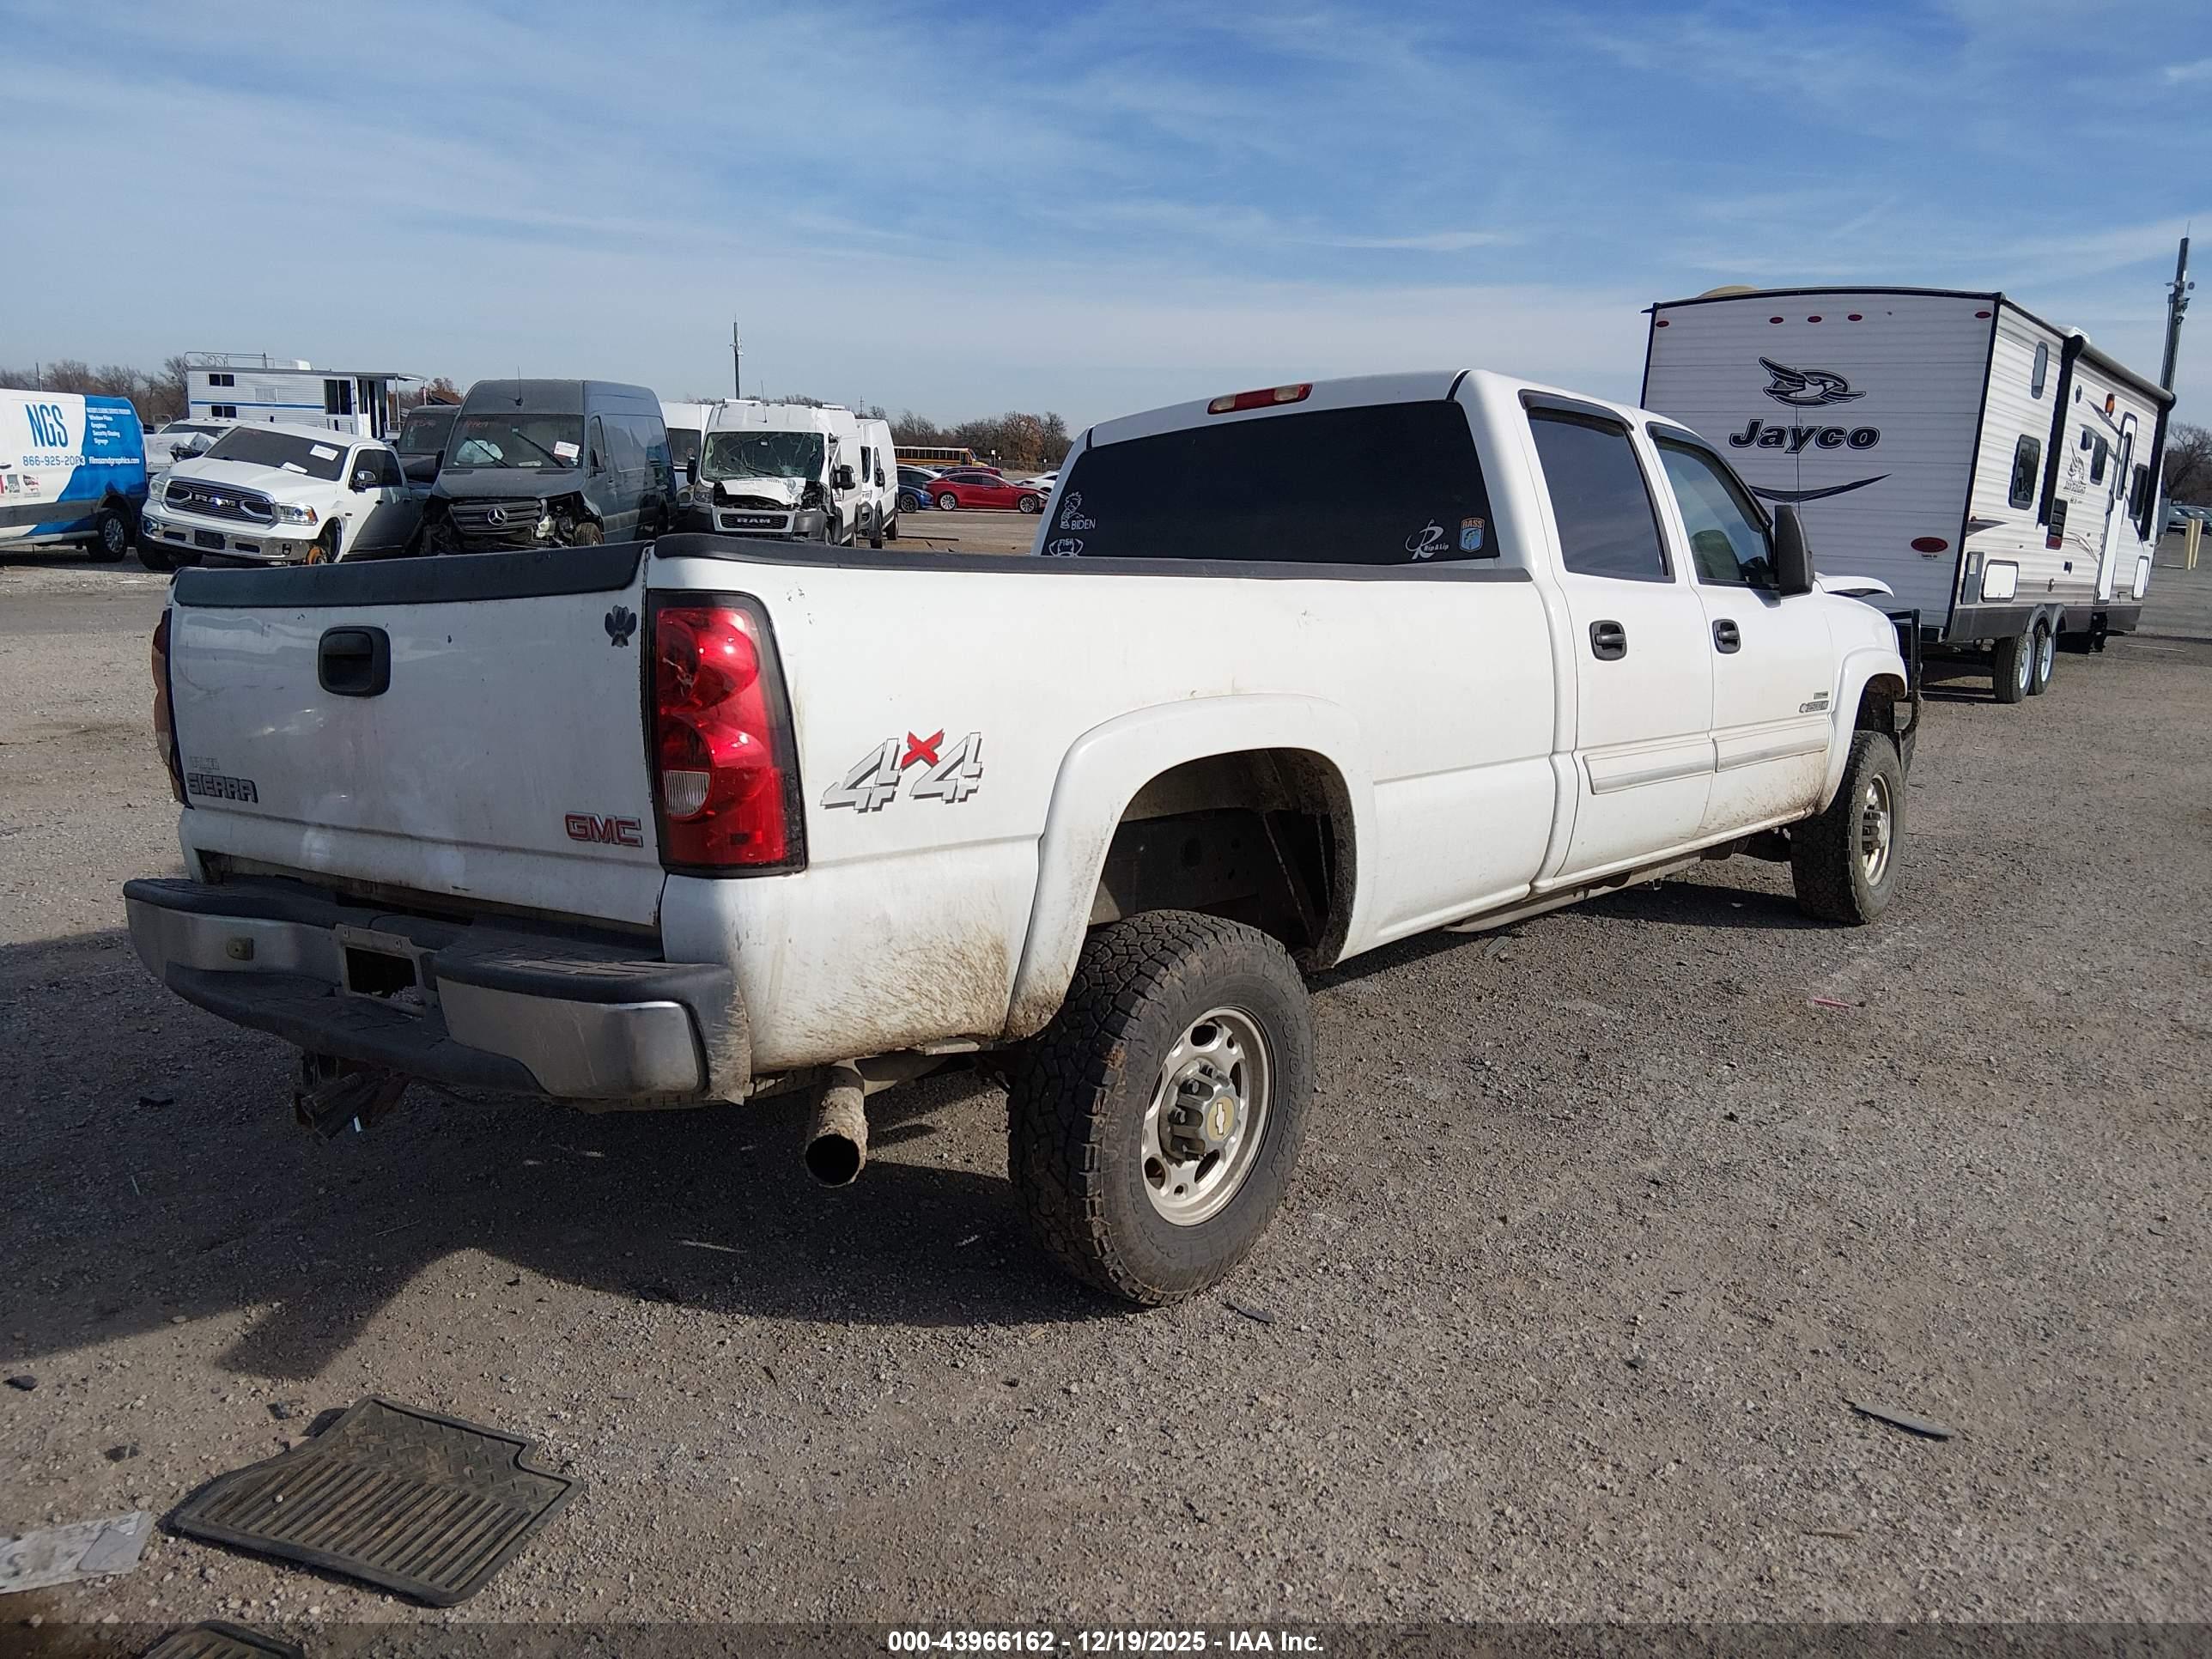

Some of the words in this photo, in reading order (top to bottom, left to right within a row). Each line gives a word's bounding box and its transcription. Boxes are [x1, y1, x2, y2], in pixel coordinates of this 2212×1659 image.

[25, 404, 69, 447] NGS
[1729, 418, 1881, 454] Jayco
[22, 455, 86, 466] 866-925-2083
[1071, 519, 1096, 531] BIDEN
[1462, 519, 1483, 529] BASS
[1059, 538, 1074, 547] FISH
[187, 772, 258, 804] SIERRA
[564, 811, 644, 848] GMC
